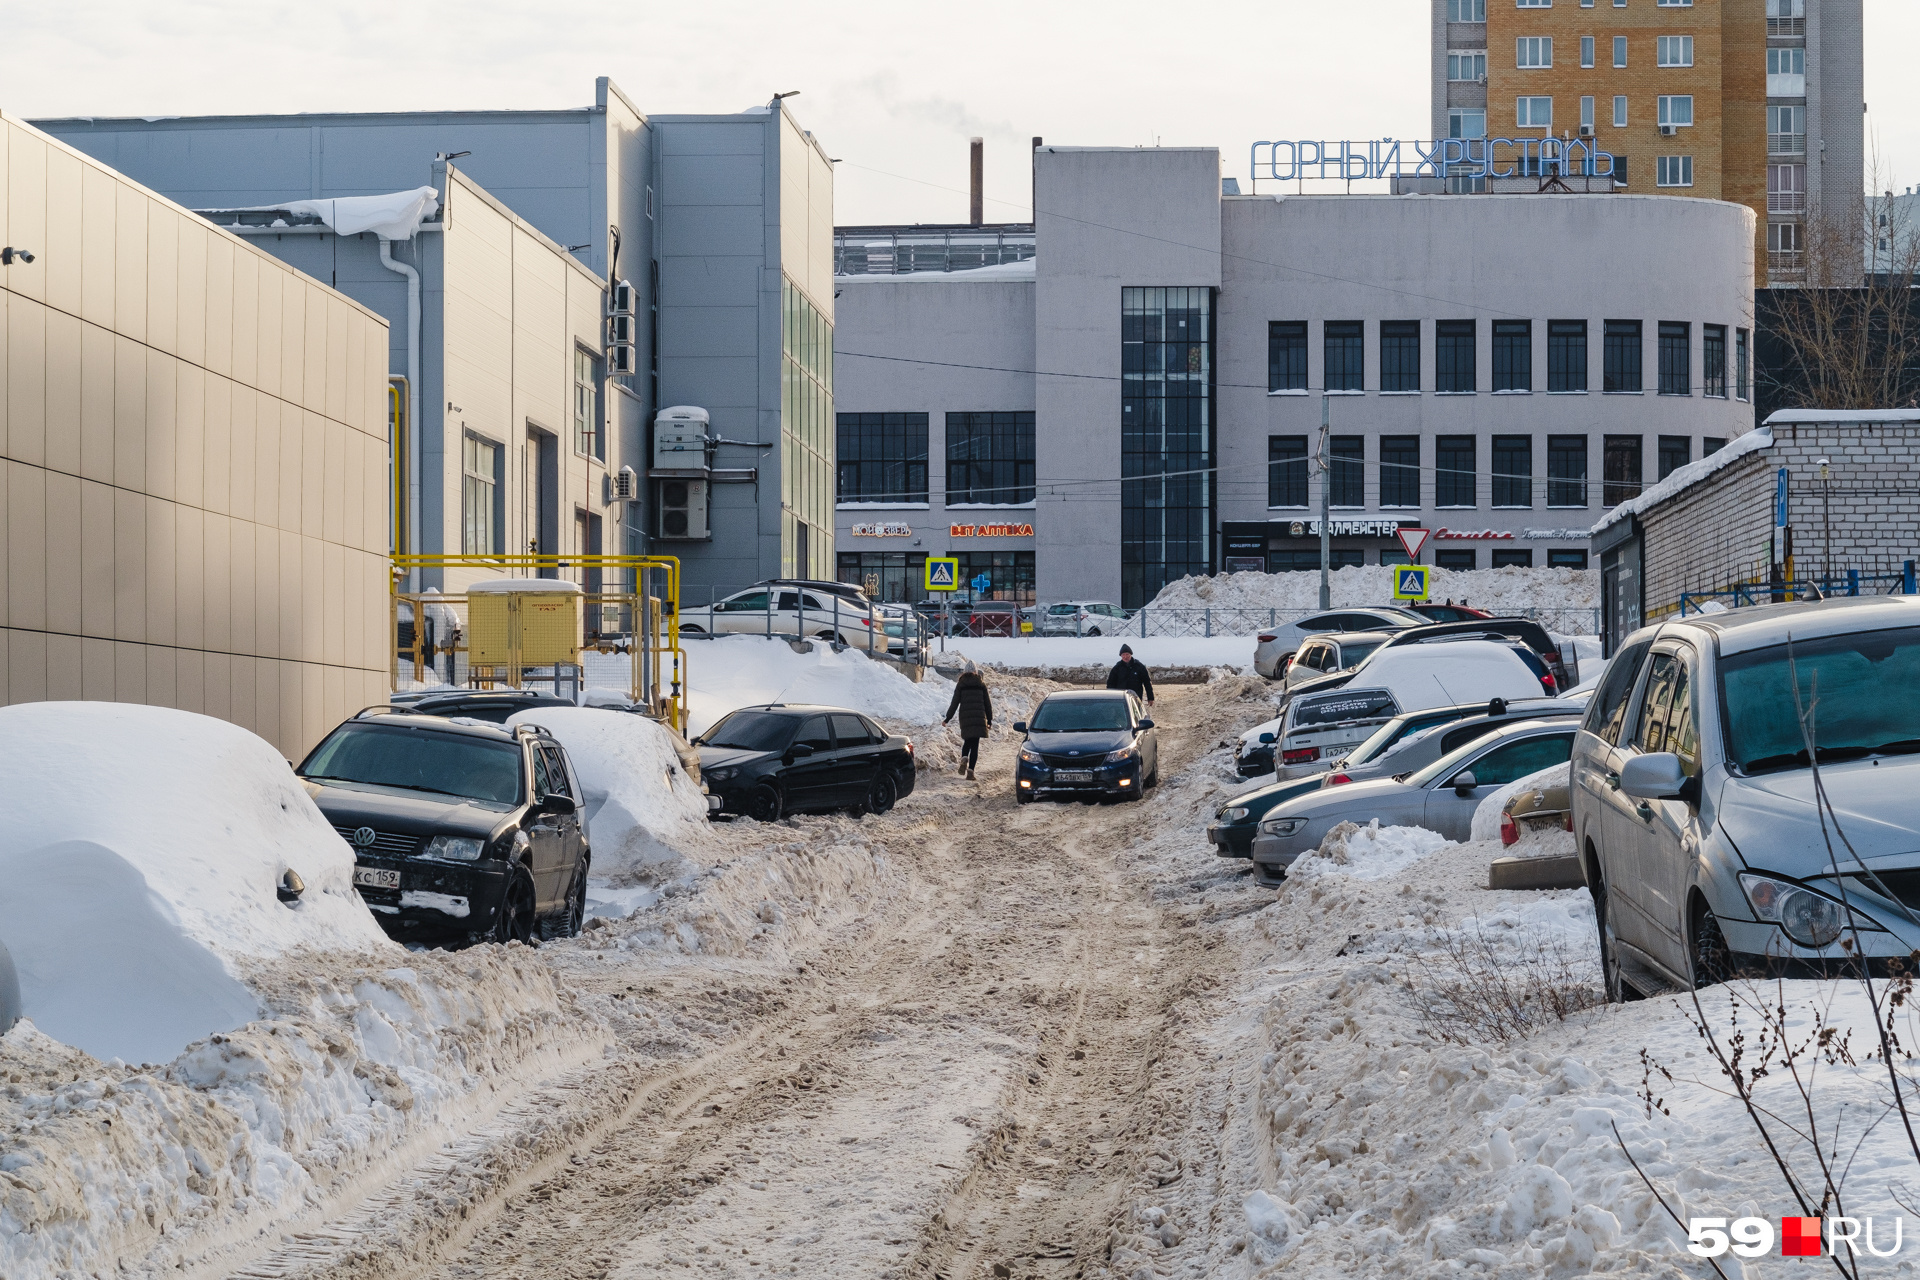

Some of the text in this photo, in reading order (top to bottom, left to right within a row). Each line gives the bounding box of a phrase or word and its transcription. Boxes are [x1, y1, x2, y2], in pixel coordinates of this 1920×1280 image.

[1251, 137, 1614, 180] ГОРНЫЙ ХРУСТАЛЬ
[851, 524, 912, 536] МОЙ ЗВЕРЬ
[951, 524, 1034, 536] ВЕТ АПТЕКА
[376, 871, 395, 882] 159
